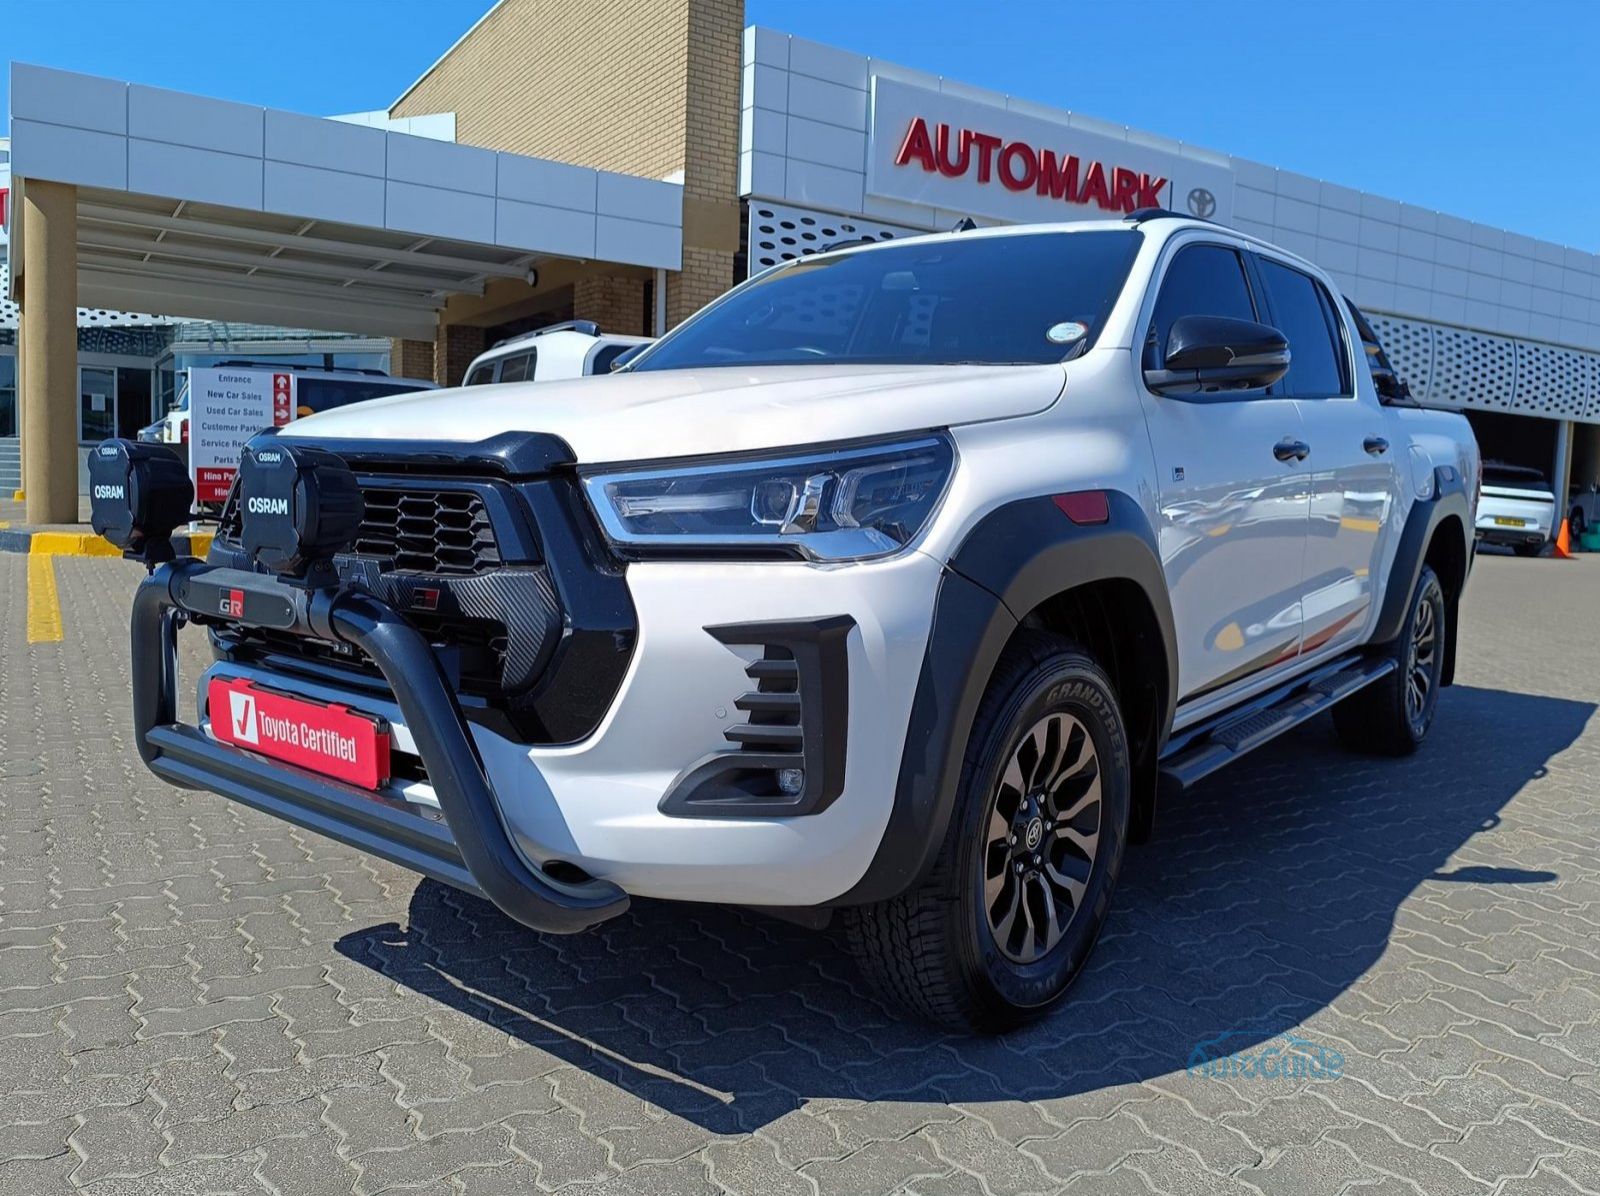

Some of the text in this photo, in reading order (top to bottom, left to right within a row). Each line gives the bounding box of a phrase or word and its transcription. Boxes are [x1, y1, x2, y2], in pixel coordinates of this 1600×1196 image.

[894, 116, 1167, 213] AUTOMARK
[218, 374, 252, 384] Entrance
[207, 390, 262, 401] New Car Sales
[206, 407, 264, 417] Used Car Sales
[201, 422, 263, 432] Customer Parkin
[201, 439, 230, 448] Service
[101, 447, 118, 456] OSRAM
[214, 455, 234, 464] Parts
[258, 452, 281, 462] OSRAM
[203, 472, 222, 481] Hino
[94, 484, 124, 500] OSRAM
[214, 488, 228, 497] Hin
[248, 497, 288, 515] OSRAM
[219, 598, 242, 616] GR
[258, 710, 357, 764] Toyota Certified
